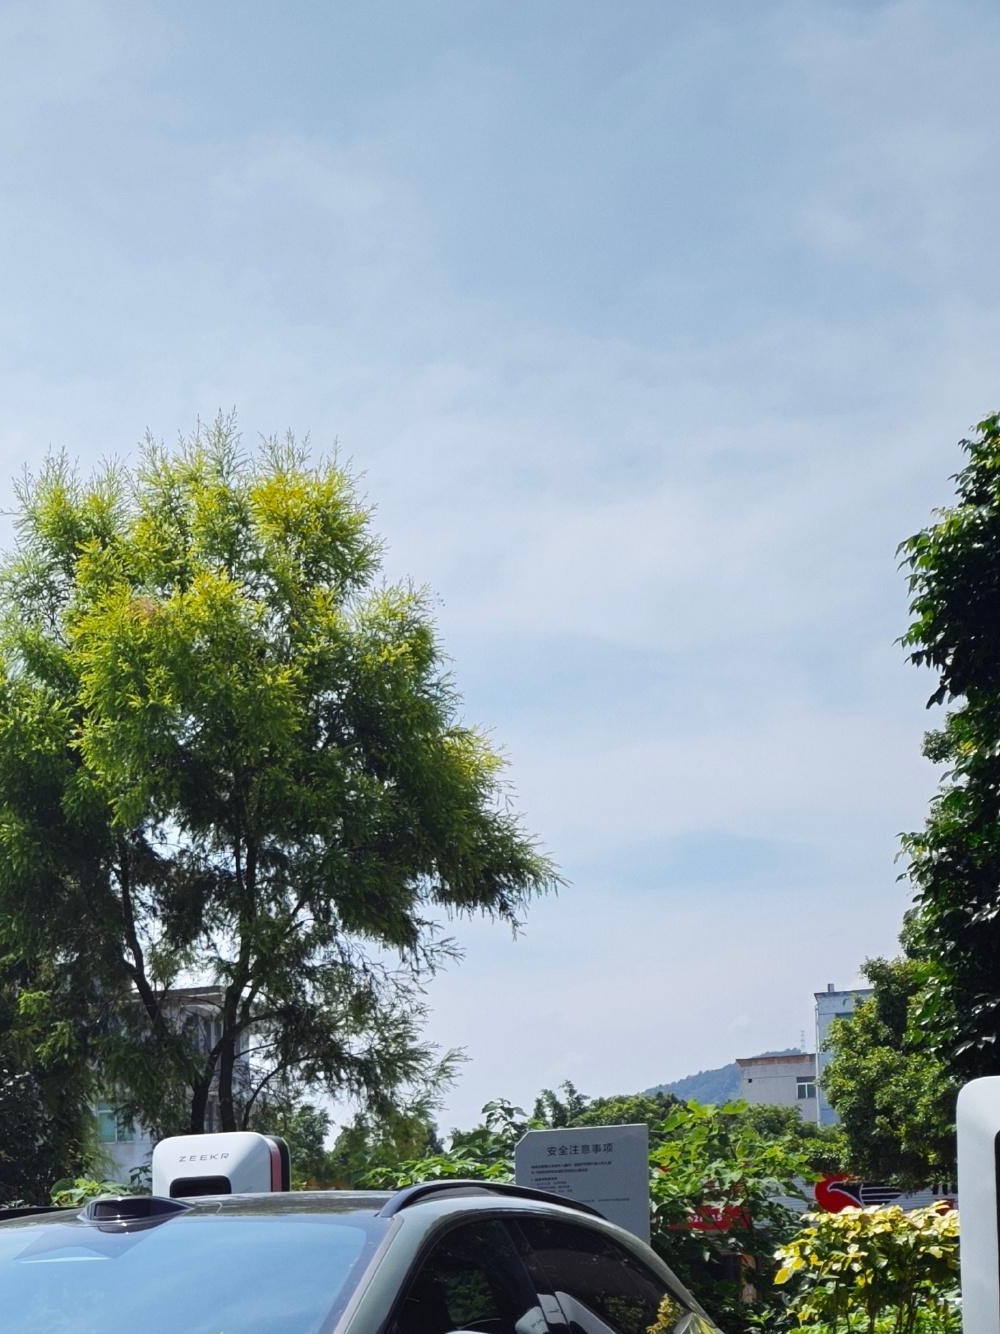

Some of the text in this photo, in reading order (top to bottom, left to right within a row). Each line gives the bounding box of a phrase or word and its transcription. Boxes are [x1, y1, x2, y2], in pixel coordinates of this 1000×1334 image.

[546, 1143, 614, 1157] 安全注意事项
[178, 1153, 230, 1162] ZEEKR
